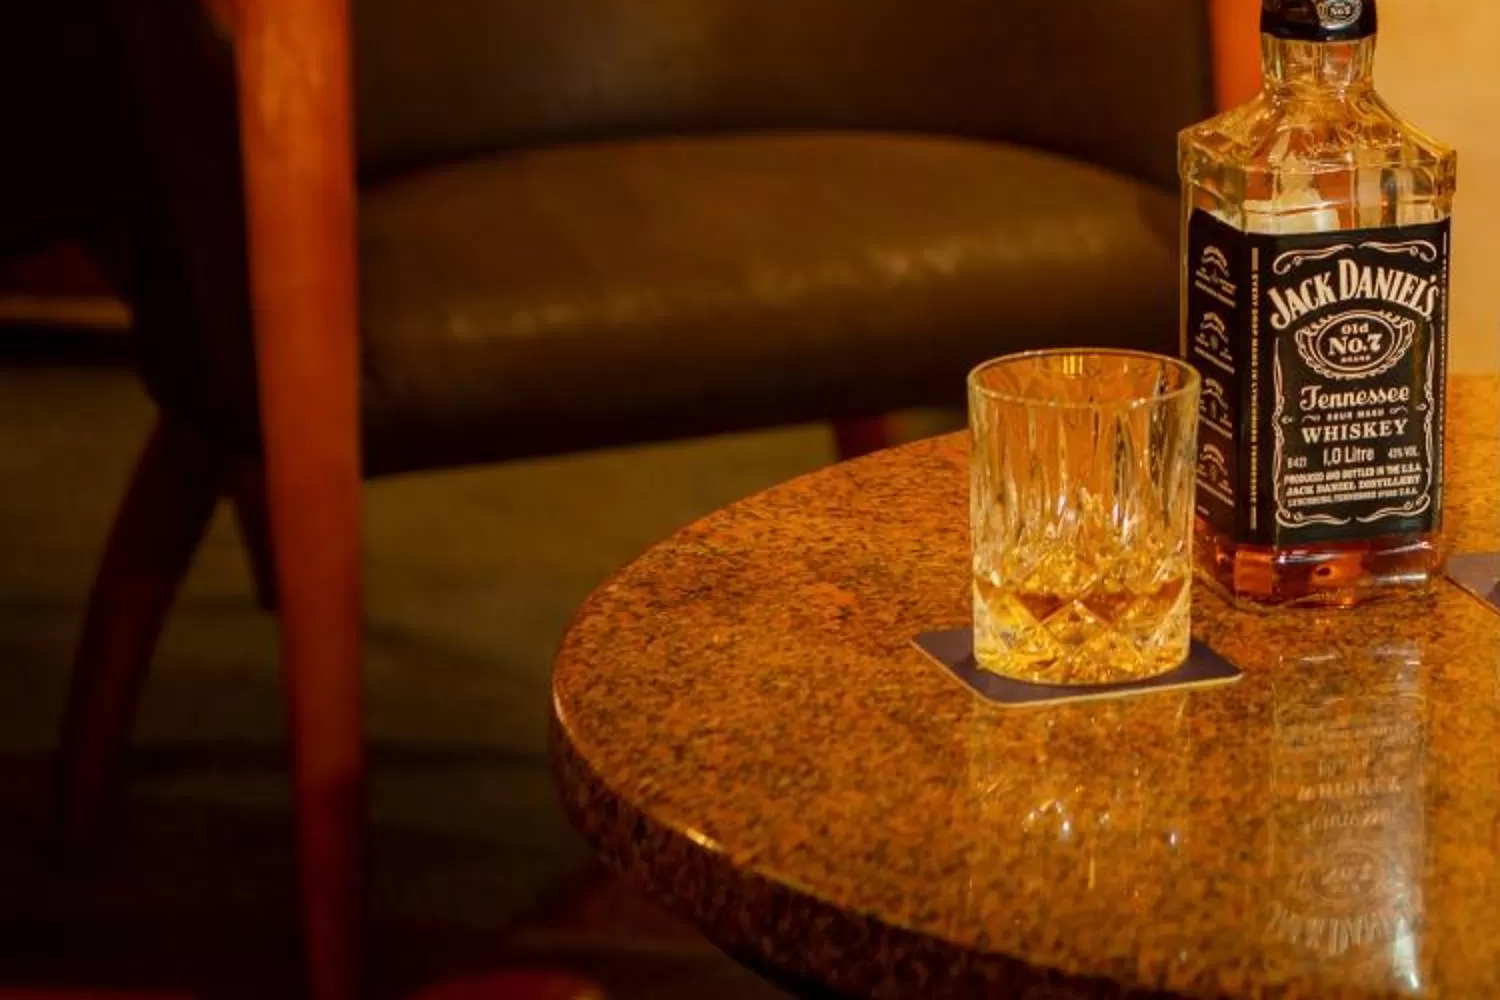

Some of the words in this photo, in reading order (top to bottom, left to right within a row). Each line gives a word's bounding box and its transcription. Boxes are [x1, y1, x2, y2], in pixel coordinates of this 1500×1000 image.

[1267, 271, 1338, 331] JACK
[1337, 258, 1441, 322] DANIEL'S
[1341, 323, 1370, 335] Old
[1300, 385, 1410, 411] Tennessee
[1302, 418, 1409, 444] WHISKEY
[1344, 445, 1375, 463] Litre
